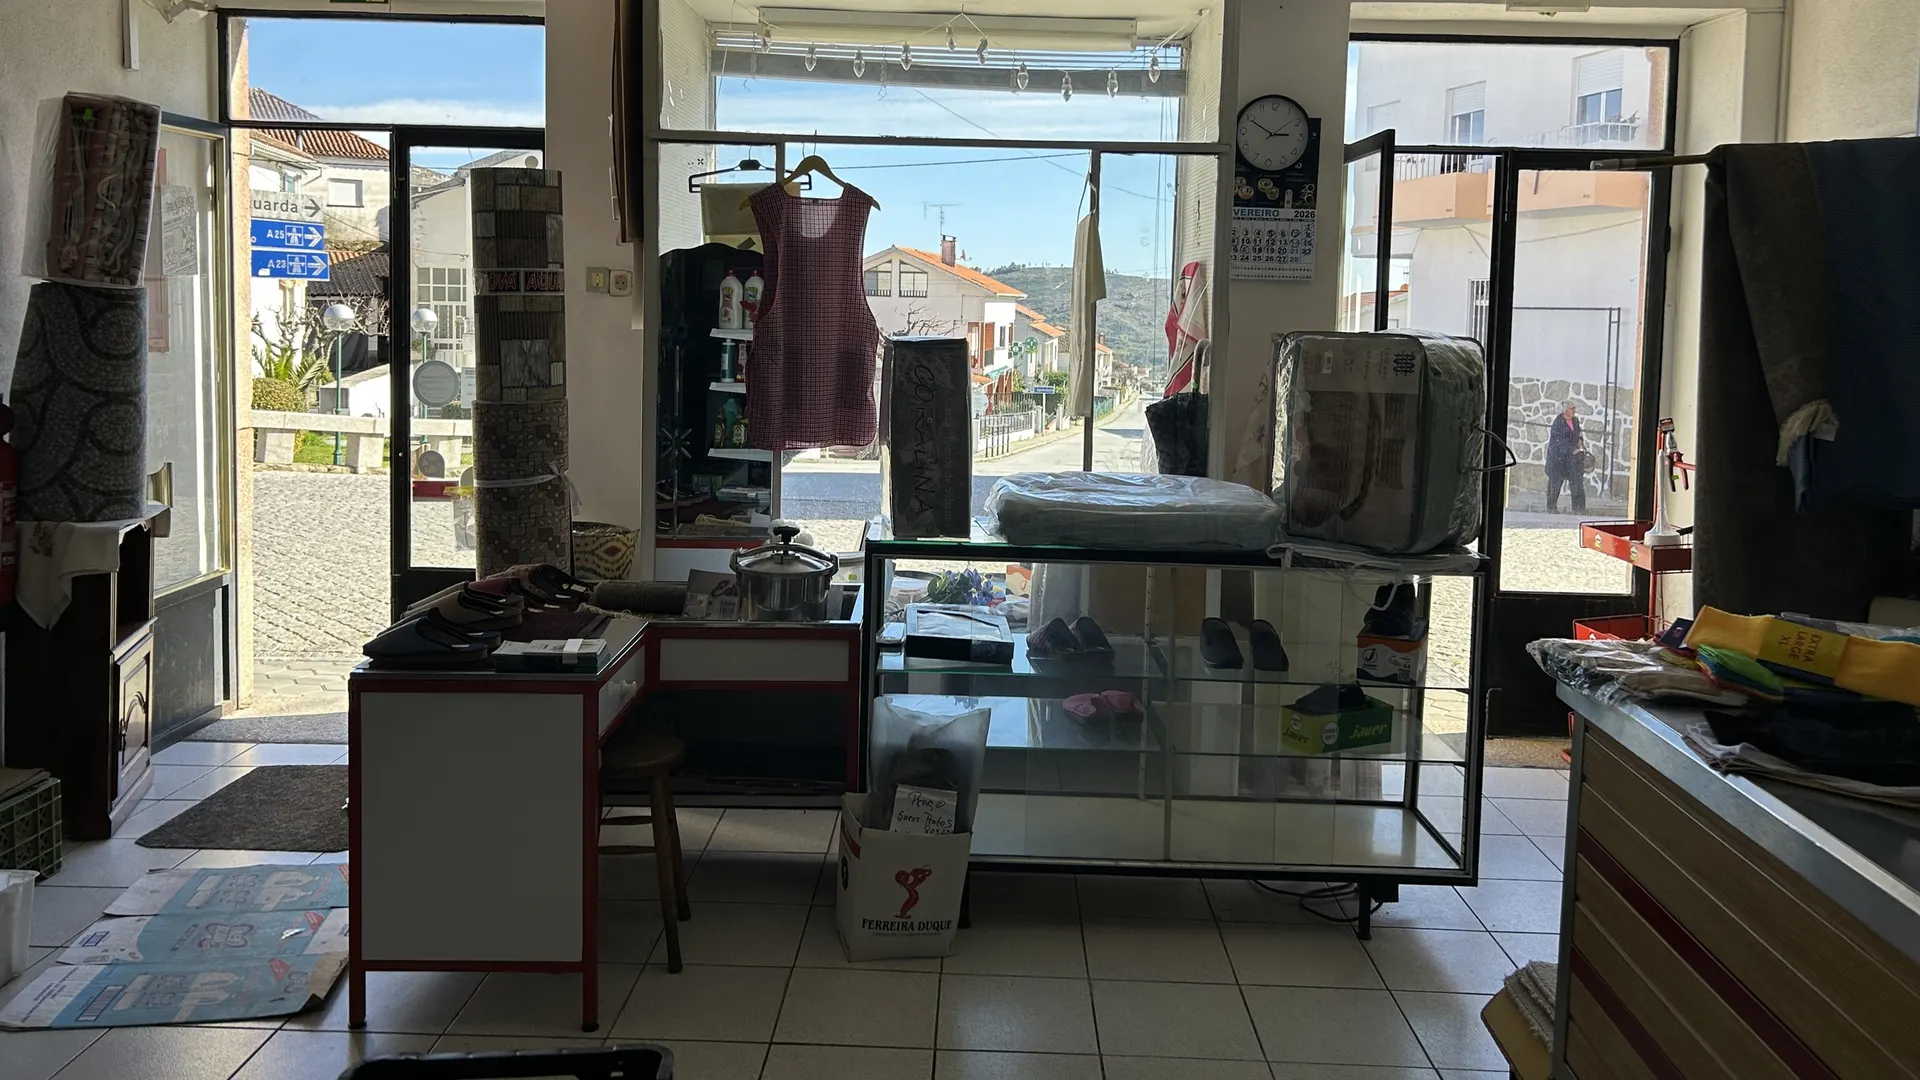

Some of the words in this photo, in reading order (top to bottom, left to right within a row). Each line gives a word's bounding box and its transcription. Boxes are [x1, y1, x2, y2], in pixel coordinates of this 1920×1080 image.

[1271, 101, 1280, 112] 12
[1246, 113, 1256, 122] 10
[1294, 117, 1302, 128] 2
[1240, 126, 1248, 136] 9
[1297, 132, 1305, 143] 3
[1242, 140, 1249, 151] 8
[1252, 152, 1260, 162] 7
[1290, 147, 1298, 156] 4
[1264, 158, 1273, 168] 6
[1279, 156, 1287, 165] 5
[253, 199, 298, 213] uarda
[1233, 208, 1279, 217] VEREIRO
[1294, 210, 1316, 218] 2026
[913, 365, 936, 516] CORALINA
[1778, 634, 1792, 647] XL
[1788, 631, 1808, 660] LARGE
[1803, 634, 1822, 662] EXTRA
[862, 919, 915, 931] FERREIRA
[917, 920, 952, 932] DUQUE
